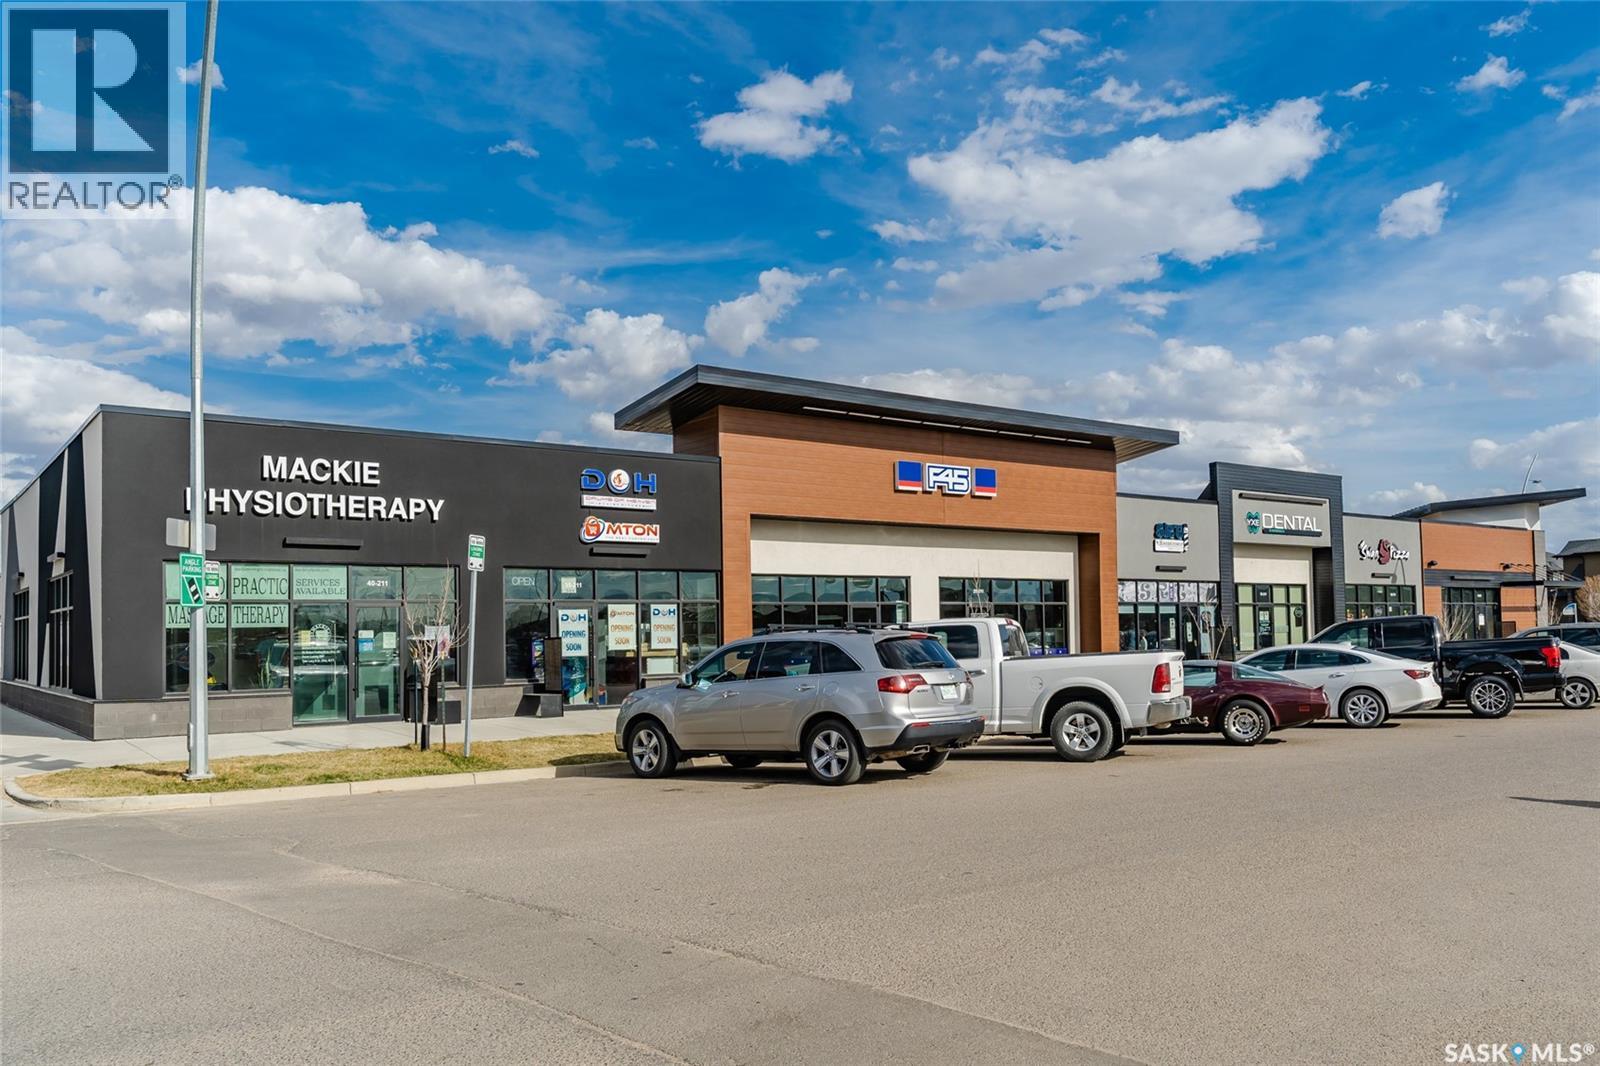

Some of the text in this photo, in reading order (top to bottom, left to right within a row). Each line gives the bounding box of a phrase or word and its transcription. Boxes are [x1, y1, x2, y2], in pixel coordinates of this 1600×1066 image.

[263, 455, 381, 485] MACKIE
[927, 465, 971, 494] F45
[1262, 512, 1322, 532] DENTAL
[295, 578, 340, 587] SERVICES
[511, 576, 536, 586] OPEN
[232, 577, 287, 595] PRACTIC
[295, 587, 346, 596] AVAILABLE
[233, 605, 287, 624] THERAPY
[611, 624, 634, 632] OPENING
[653, 624, 676, 632] OPENING
[561, 630, 586, 639] OPENING
[614, 637, 630, 645] SOON
[657, 636, 672, 644] SOON
[565, 643, 582, 651] SOON
